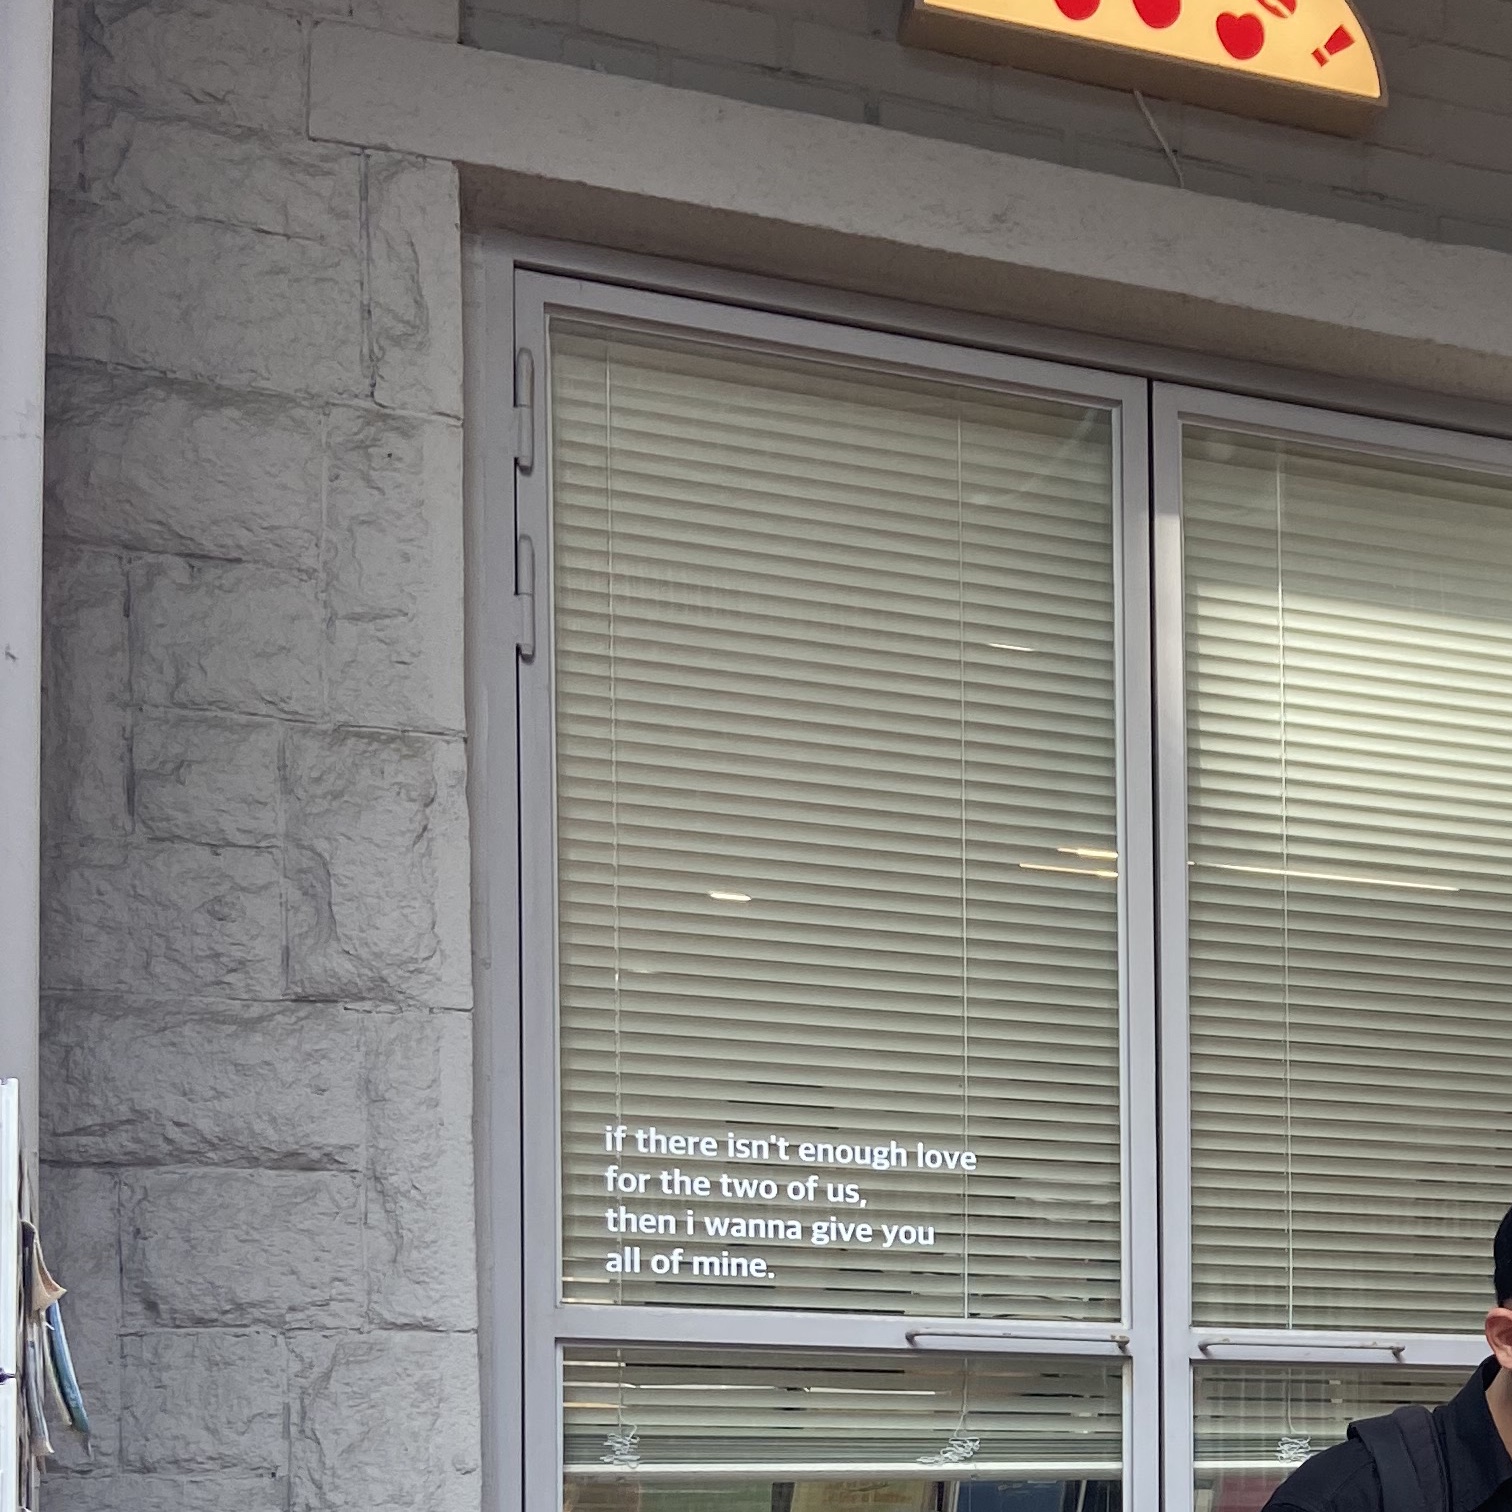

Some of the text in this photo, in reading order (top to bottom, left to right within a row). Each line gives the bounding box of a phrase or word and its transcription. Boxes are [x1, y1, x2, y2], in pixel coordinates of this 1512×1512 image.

[604, 1125, 978, 1172] if there isn't enough love
[604, 1165, 868, 1209] for the two of us,
[605, 1206, 935, 1248] then i wanna give you
[605, 1246, 776, 1279] all of mine.
